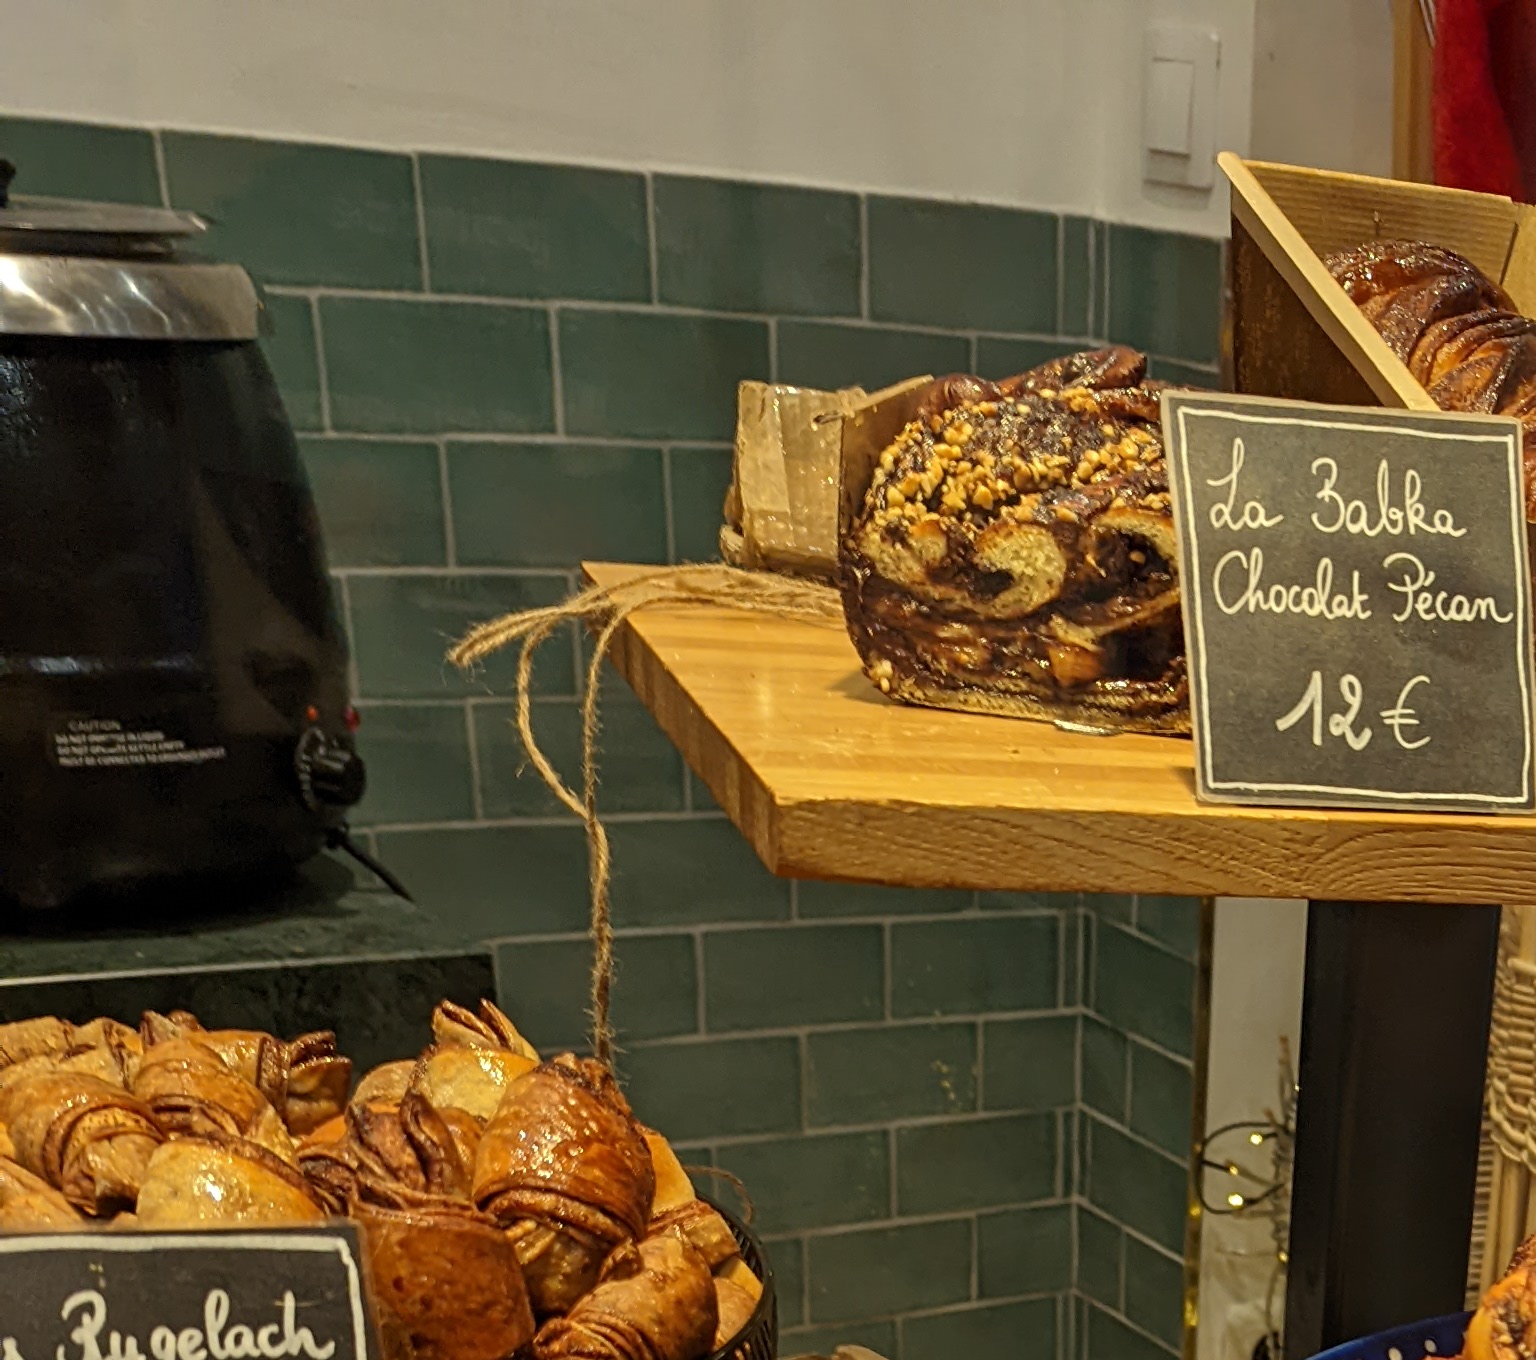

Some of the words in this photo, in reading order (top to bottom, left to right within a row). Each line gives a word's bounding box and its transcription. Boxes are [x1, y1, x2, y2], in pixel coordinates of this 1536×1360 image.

[1207, 438, 1284, 531] La
[1311, 458, 1467, 537] Babka
[1213, 547, 1372, 620] Chocolat
[1383, 552, 1513, 624] Pécan
